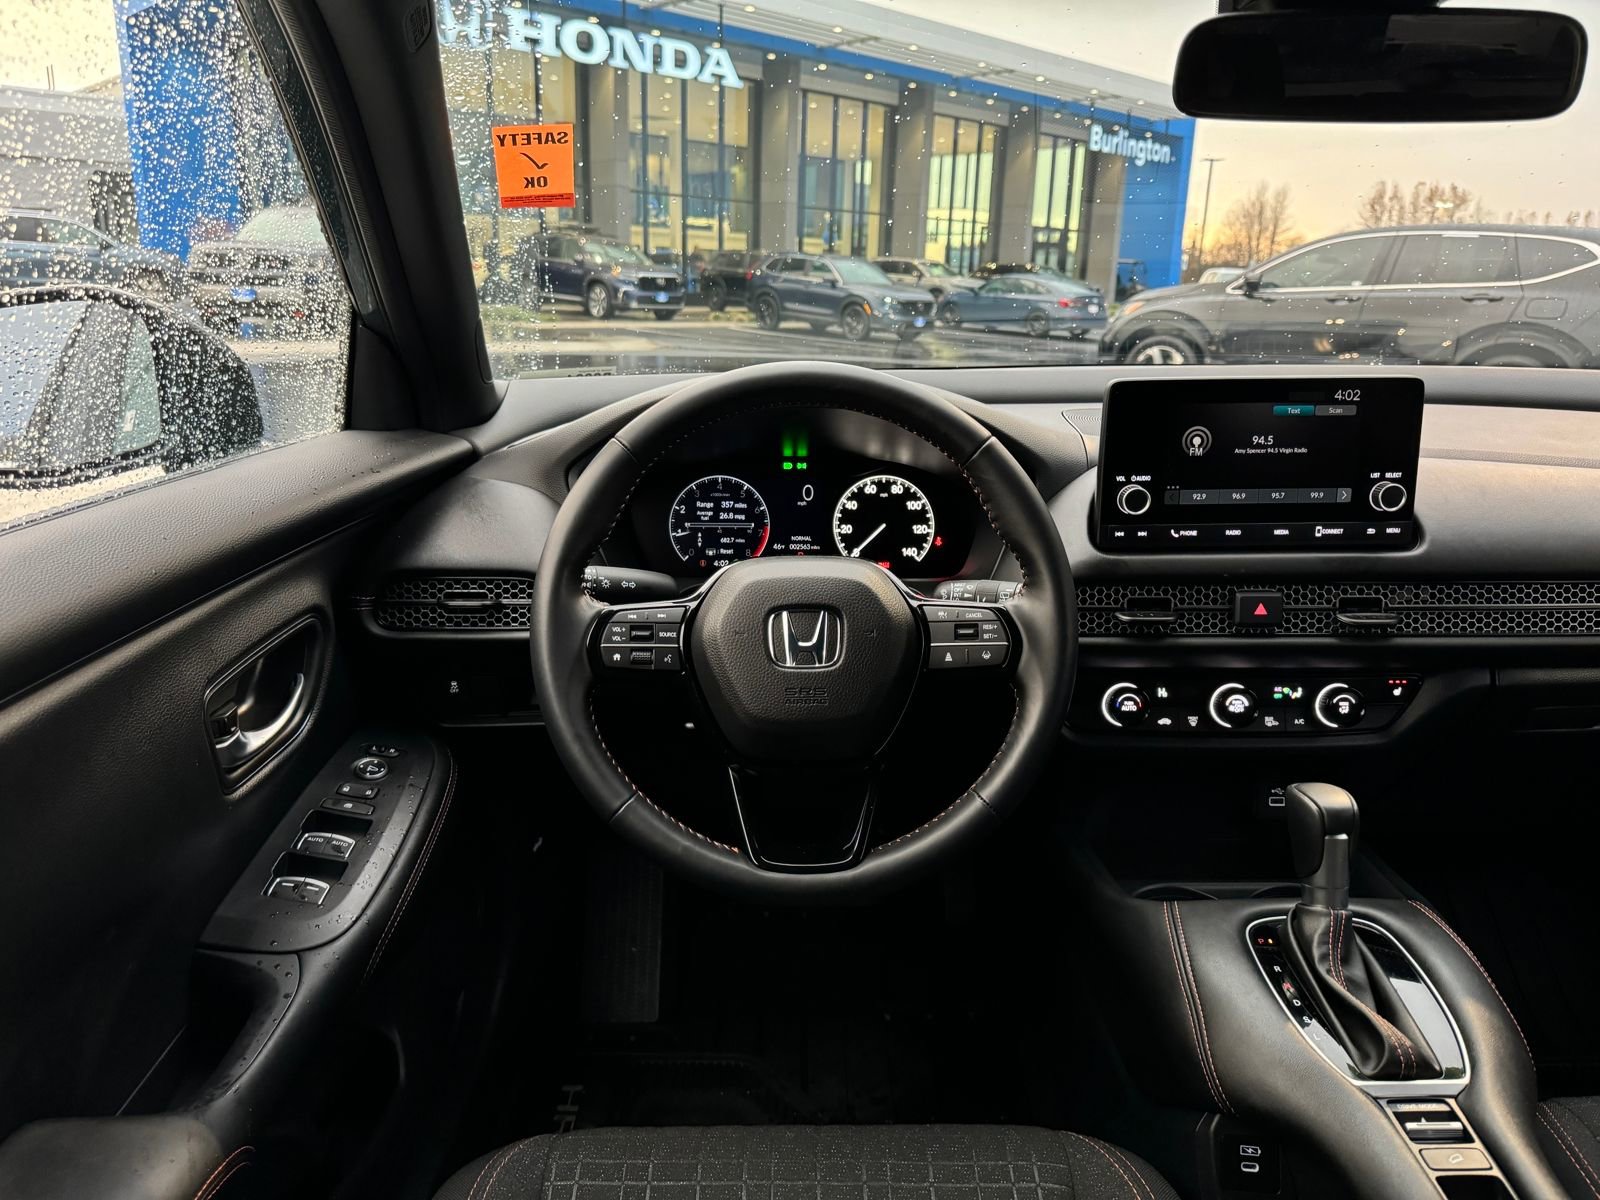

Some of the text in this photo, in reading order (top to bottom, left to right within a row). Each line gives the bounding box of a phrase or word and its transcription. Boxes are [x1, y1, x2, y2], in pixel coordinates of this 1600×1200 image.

[507, 8, 743, 89] HONDA
[1089, 124, 1171, 167] Burlington
[1334, 389, 1361, 402] 4:02
[1286, 407, 1301, 415] Text
[1328, 406, 1344, 415] Scan
[1252, 435, 1274, 446] 94.5
[1189, 447, 1204, 457] FM
[1280, 447, 1294, 455] Virgin
[803, 485, 814, 501] 0
[864, 485, 876, 494] 60
[891, 485, 903, 494] 80
[696, 501, 714, 509] Range
[845, 501, 857, 510] 40
[906, 501, 922, 510] 100
[680, 506, 685, 514] 2
[840, 525, 852, 533] 20
[912, 525, 927, 534] 120
[901, 548, 917, 557] 140
